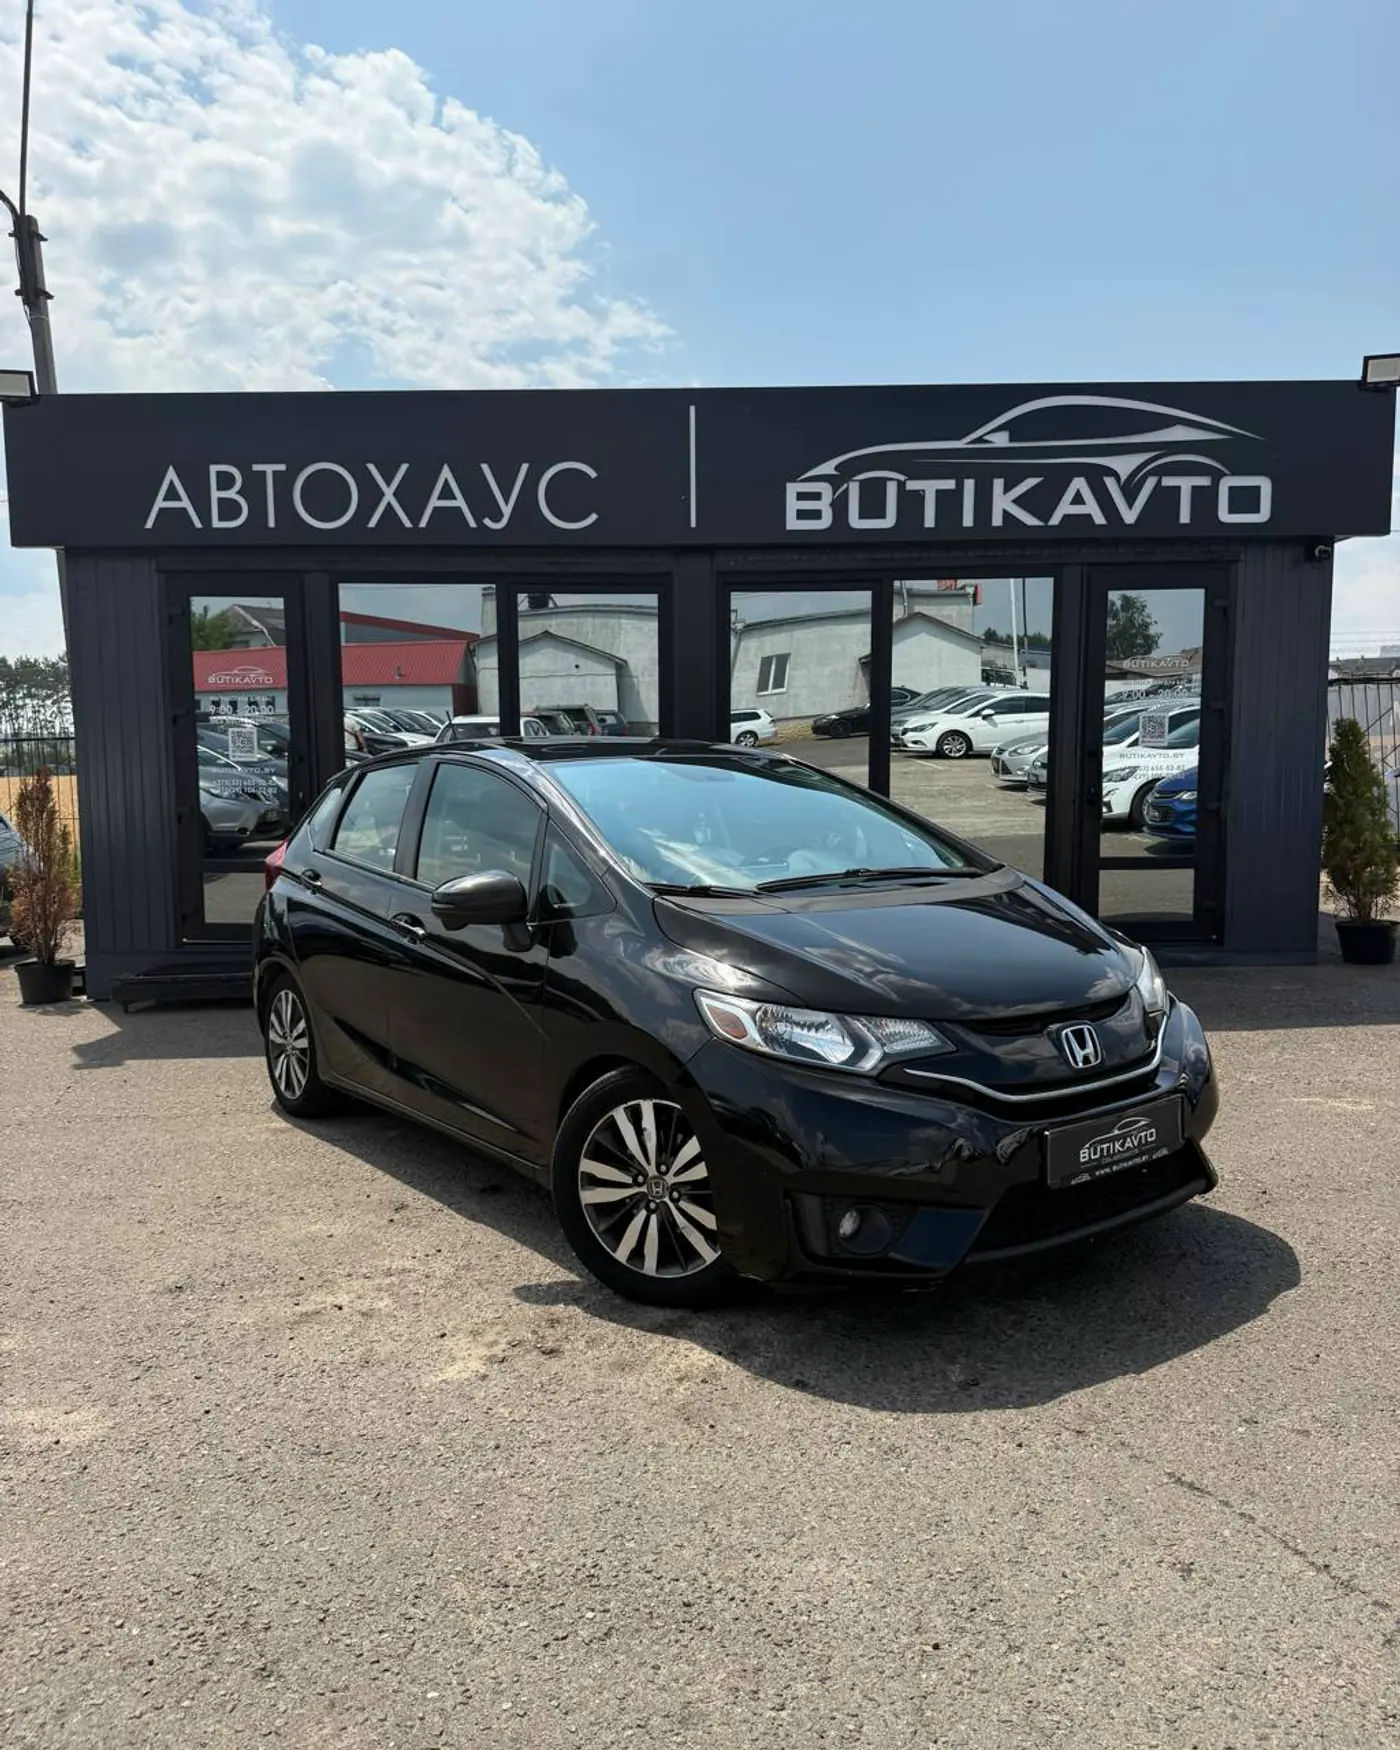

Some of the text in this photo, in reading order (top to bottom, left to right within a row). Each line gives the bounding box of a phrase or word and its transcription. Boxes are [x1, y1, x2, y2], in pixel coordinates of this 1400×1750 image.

[144, 461, 598, 530] АВТОХАУС
[785, 475, 1272, 531] BUTIKAVTO
[208, 675, 274, 684] BUTIKAVTO
[1123, 659, 1189, 668] BUTIKAVTO
[1080, 1128, 1157, 1162] BUTIKAVTO
